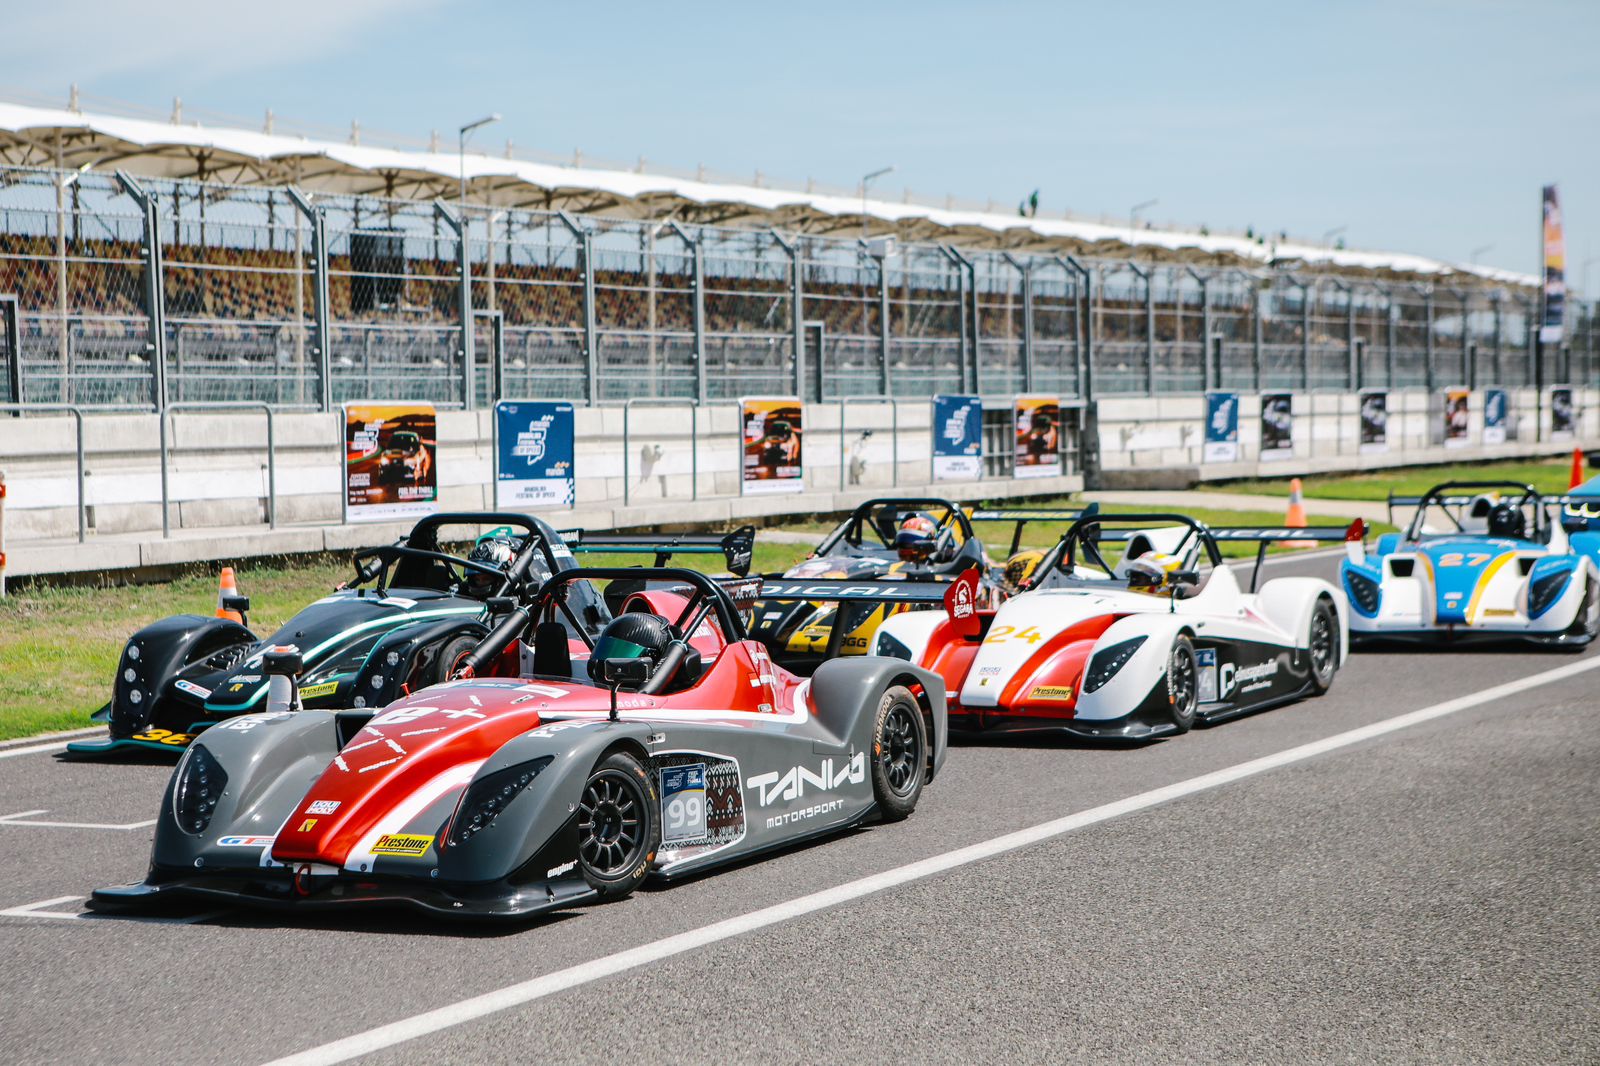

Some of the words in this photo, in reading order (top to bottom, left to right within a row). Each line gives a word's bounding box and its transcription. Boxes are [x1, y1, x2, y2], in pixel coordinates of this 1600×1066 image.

[1438, 553, 1491, 567] 27
[984, 625, 1042, 644] 24
[746, 751, 865, 807] TANIA
[668, 797, 701, 829] 99
[766, 799, 844, 829] MOTORSPORT
[376, 835, 430, 849] Prestone
